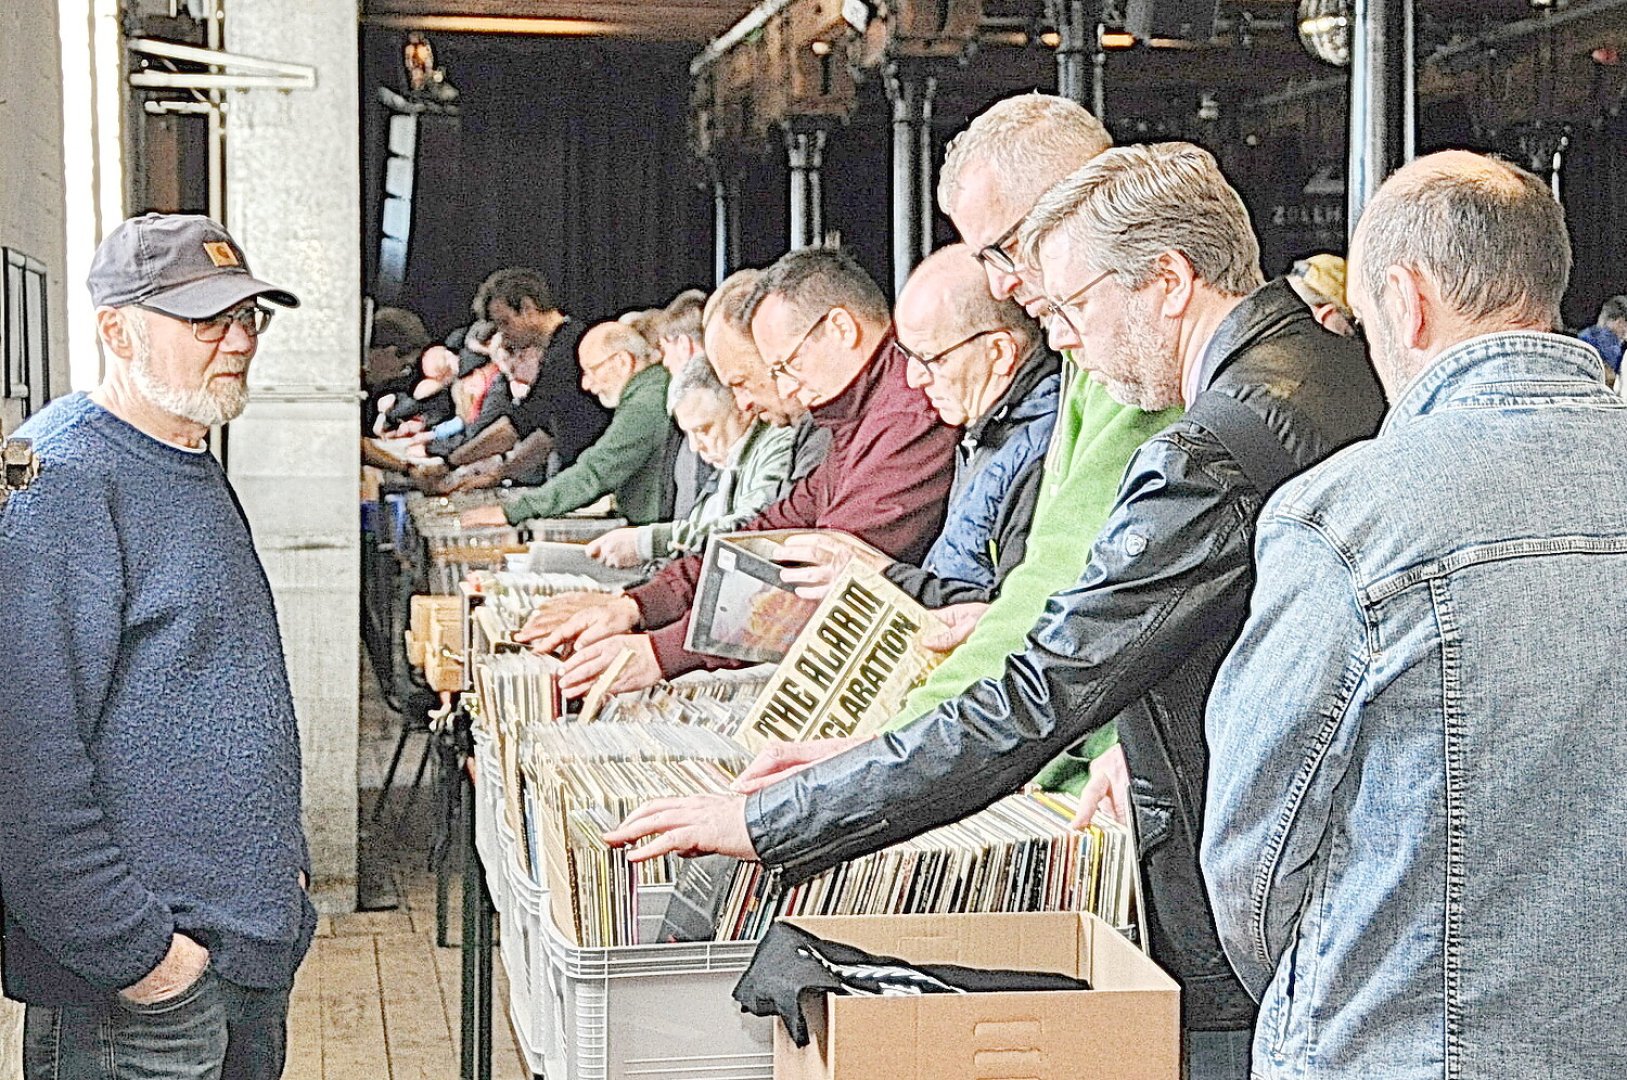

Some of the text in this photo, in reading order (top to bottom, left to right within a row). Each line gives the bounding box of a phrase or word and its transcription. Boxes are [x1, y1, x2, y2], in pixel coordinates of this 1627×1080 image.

[752, 577, 886, 743] THE ALARM
[812, 610, 921, 740] CLARATION
